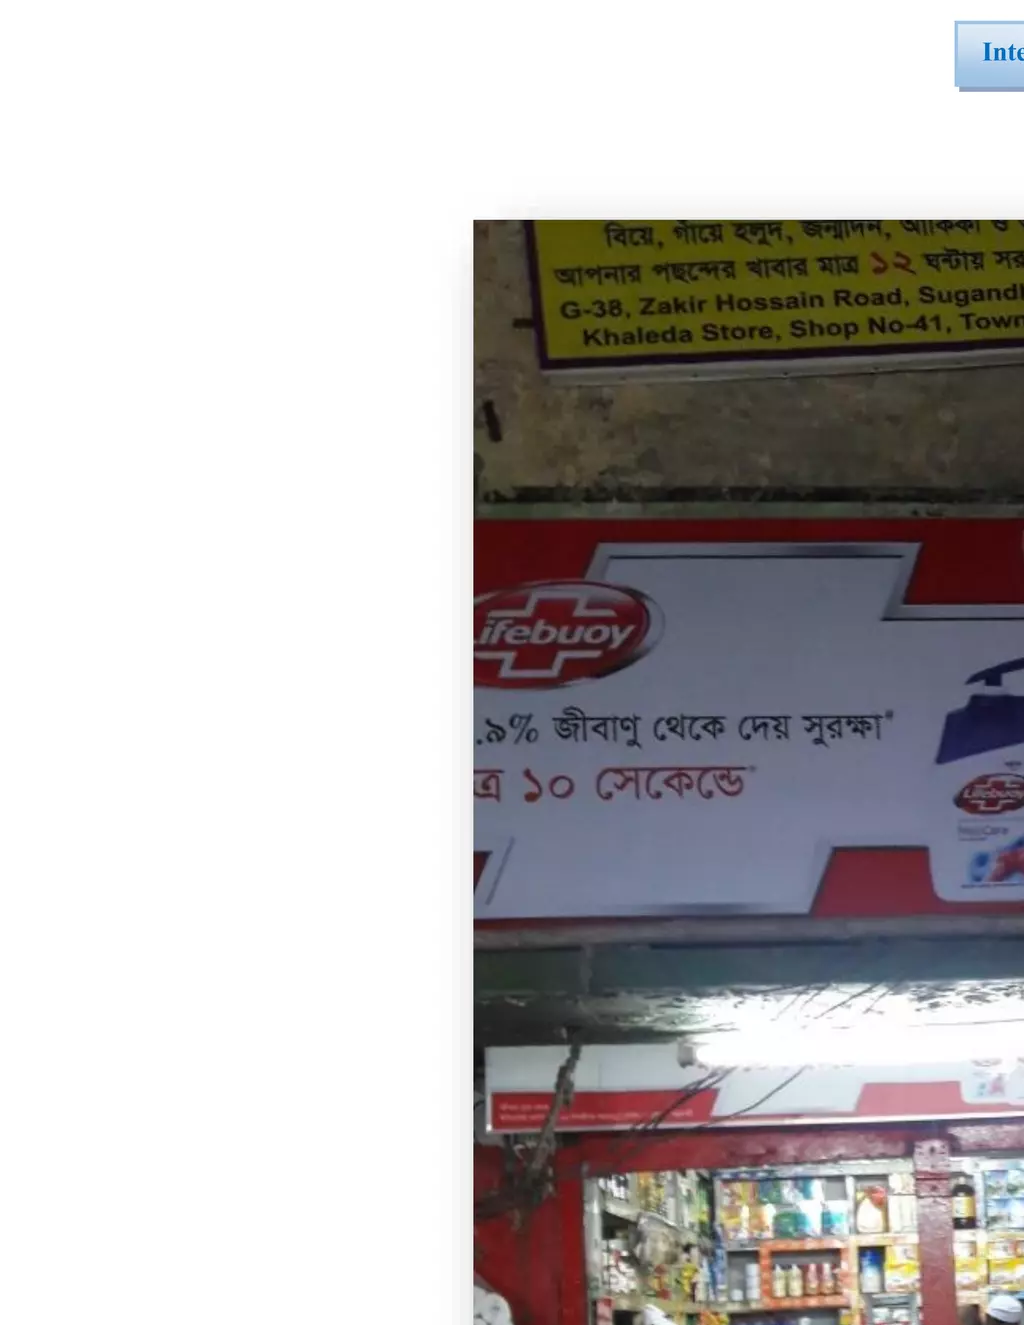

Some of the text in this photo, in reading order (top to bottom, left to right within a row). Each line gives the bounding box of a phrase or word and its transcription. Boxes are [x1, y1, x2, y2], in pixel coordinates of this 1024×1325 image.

[553, 264, 643, 287] আপনার
[652, 260, 736, 285] পছন্দের
[746, 256, 809, 279] খাবার
[818, 254, 859, 276] মাত্র
[869, 250, 918, 276] ১২
[560, 299, 631, 320] G-38,
[640, 295, 708, 316] Zakir
[716, 290, 825, 313] Hossain
[834, 287, 910, 309] Road,
[583, 325, 694, 347] Khaleda
[702, 322, 782, 343] Store,
[790, 318, 860, 341] Shop
[868, 314, 952, 336] No-41,
[474, 618, 635, 650] ifebuoy
[552, 705, 642, 749] জীবাণু
[654, 714, 727, 742] থেকে
[740, 714, 792, 743] দেয়
[523, 767, 576, 804] ১০
